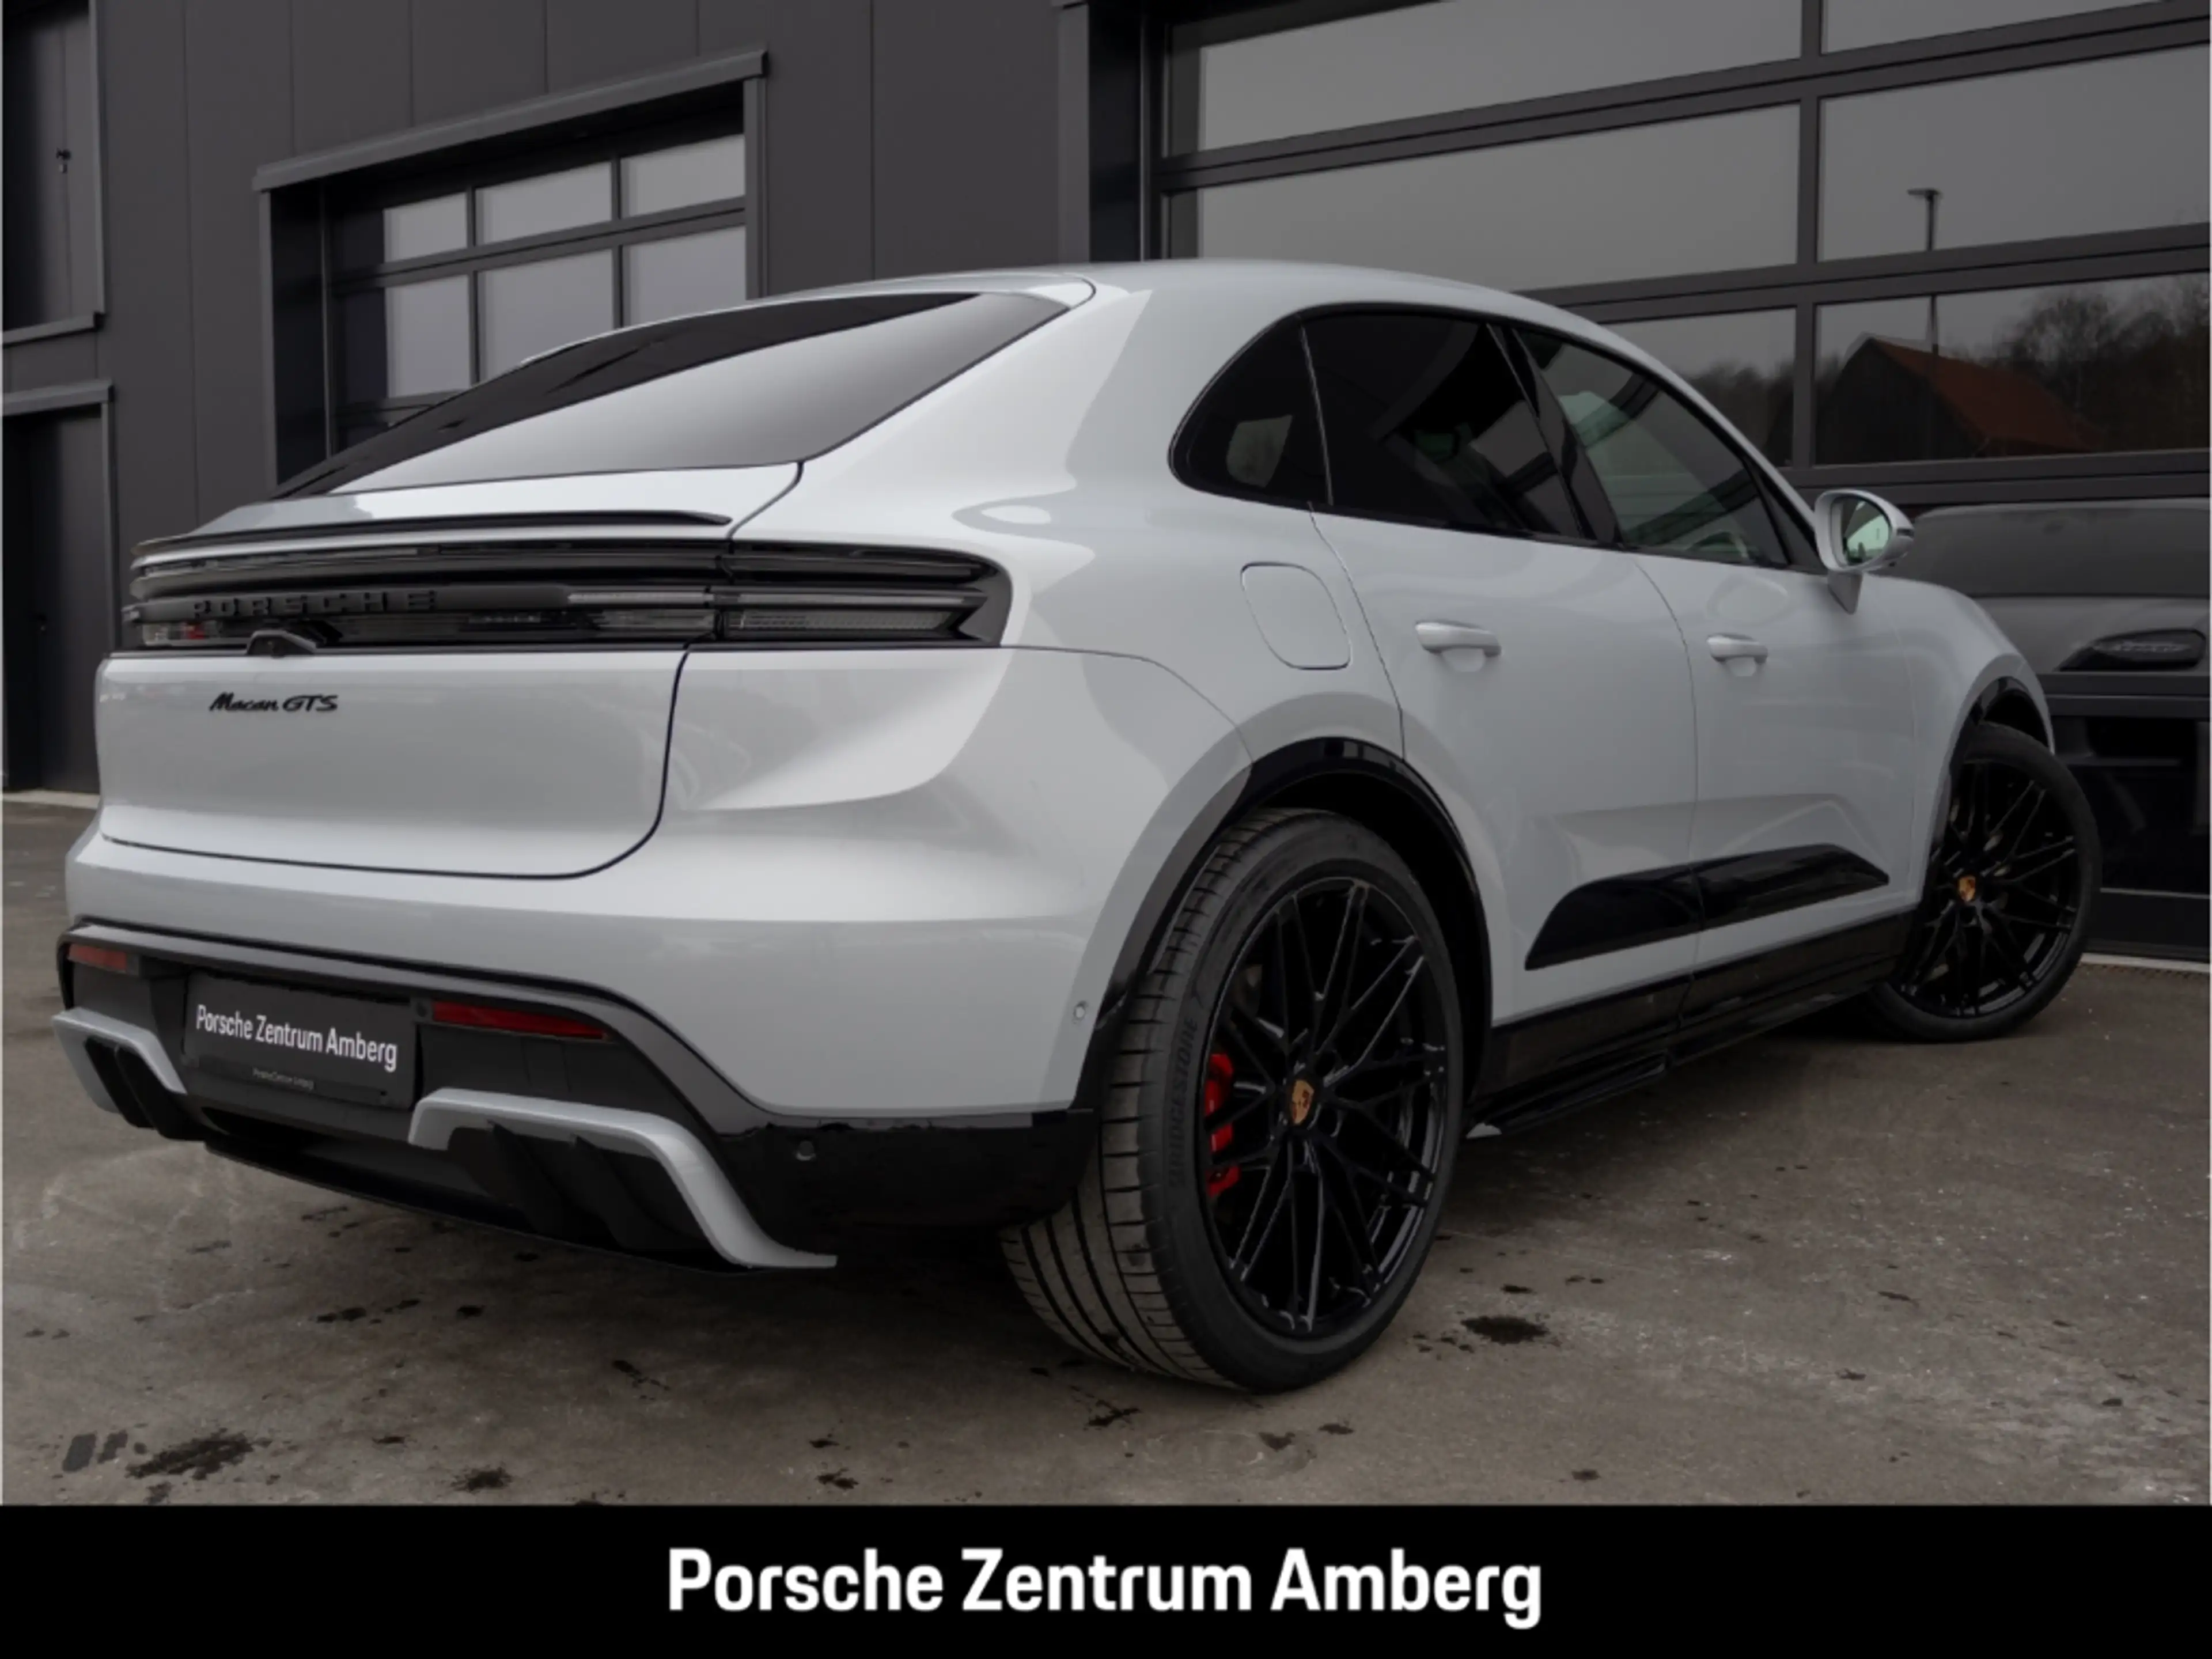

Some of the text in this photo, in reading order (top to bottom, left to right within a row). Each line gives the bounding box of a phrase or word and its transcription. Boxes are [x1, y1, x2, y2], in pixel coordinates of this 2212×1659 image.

[192, 590, 437, 618] PORSCHE
[209, 691, 338, 711] Macan GTS
[196, 1005, 397, 1073] Porsche Zentrum Amberg
